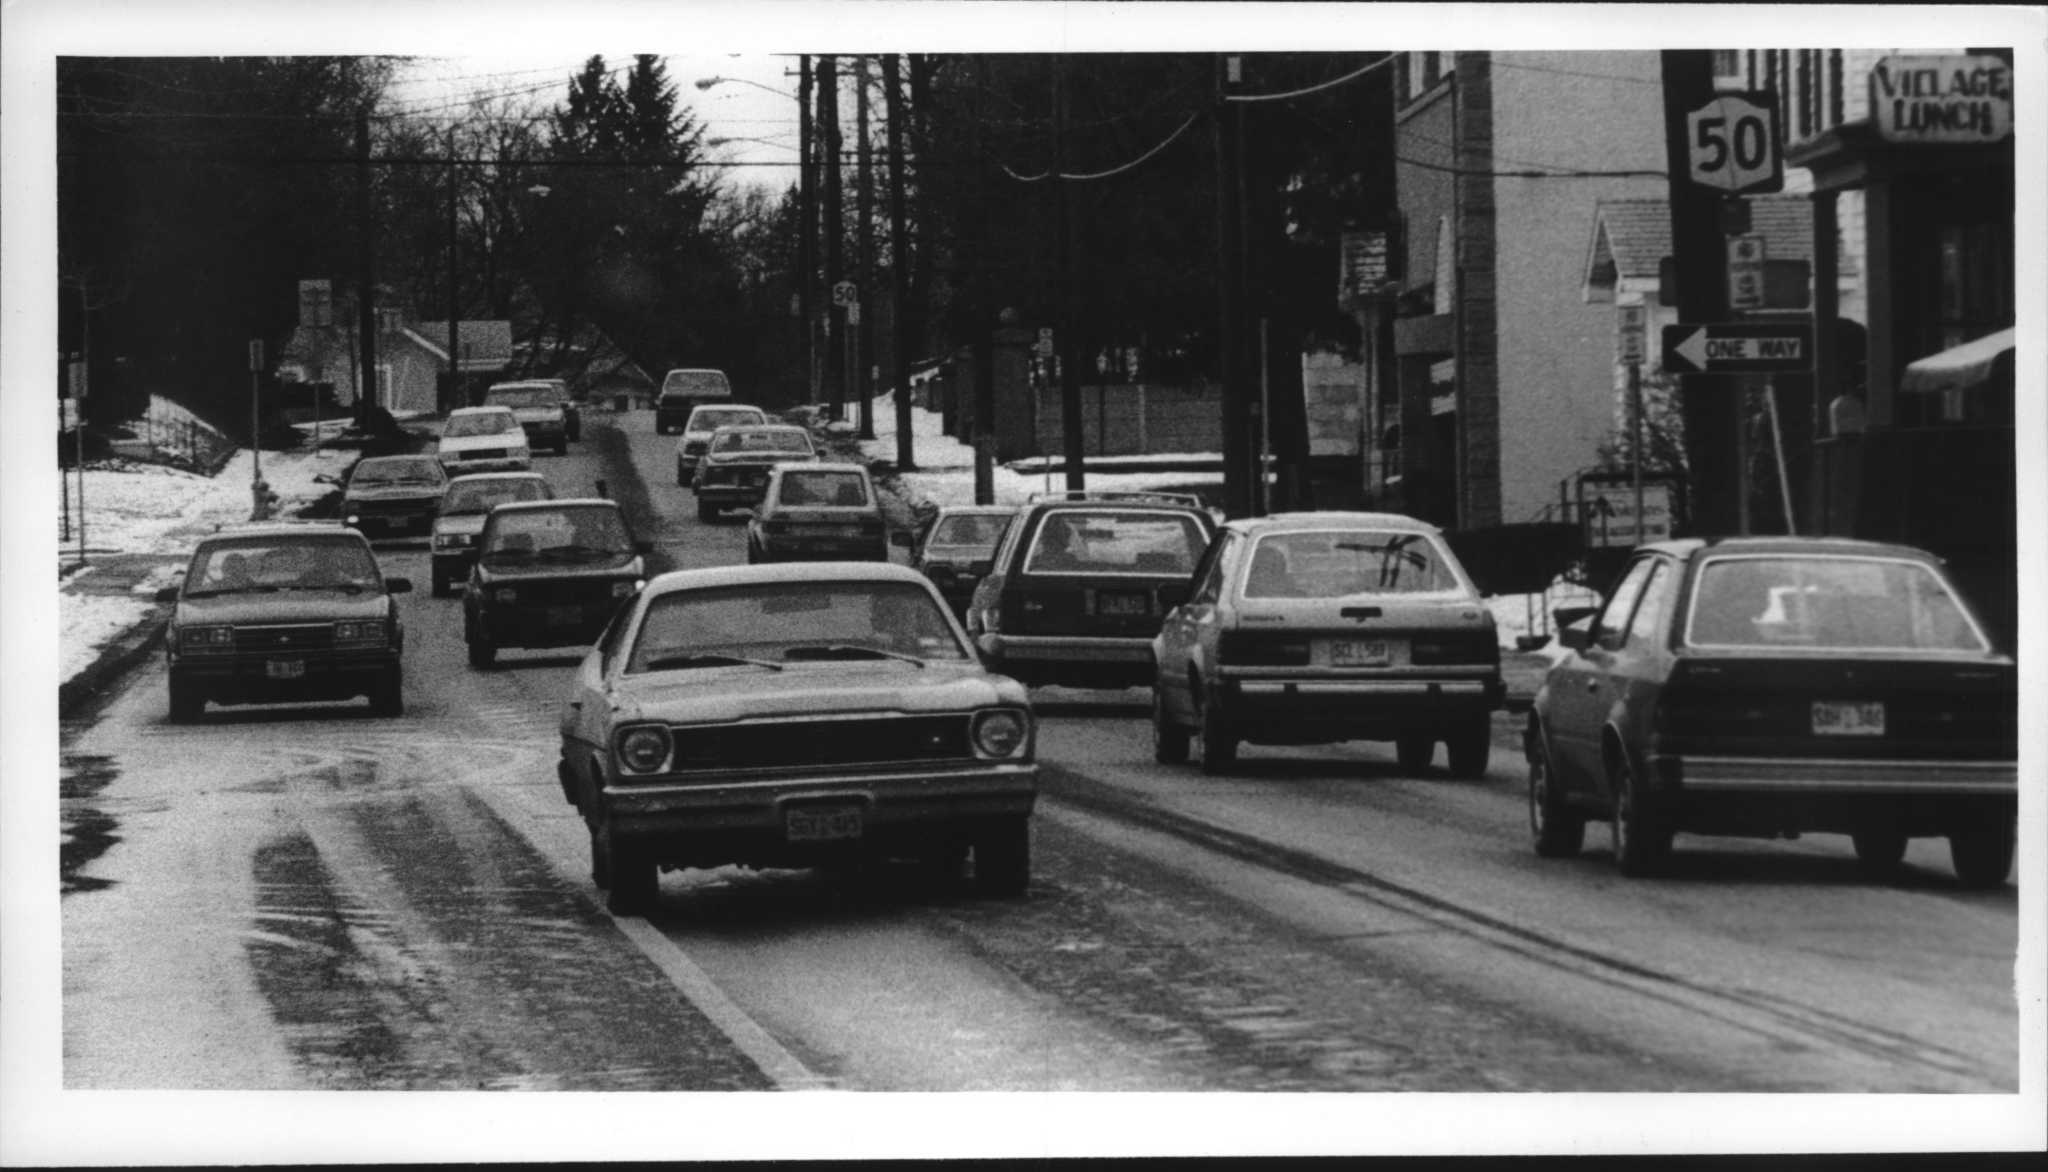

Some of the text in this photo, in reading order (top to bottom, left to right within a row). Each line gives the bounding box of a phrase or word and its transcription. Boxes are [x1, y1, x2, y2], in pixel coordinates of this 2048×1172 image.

[1876, 64, 2008, 99] VILLAGE
[1893, 99, 1993, 135] LUNCH
[1697, 114, 1767, 173] 50
[1705, 339, 1800, 358] ONE WAY
